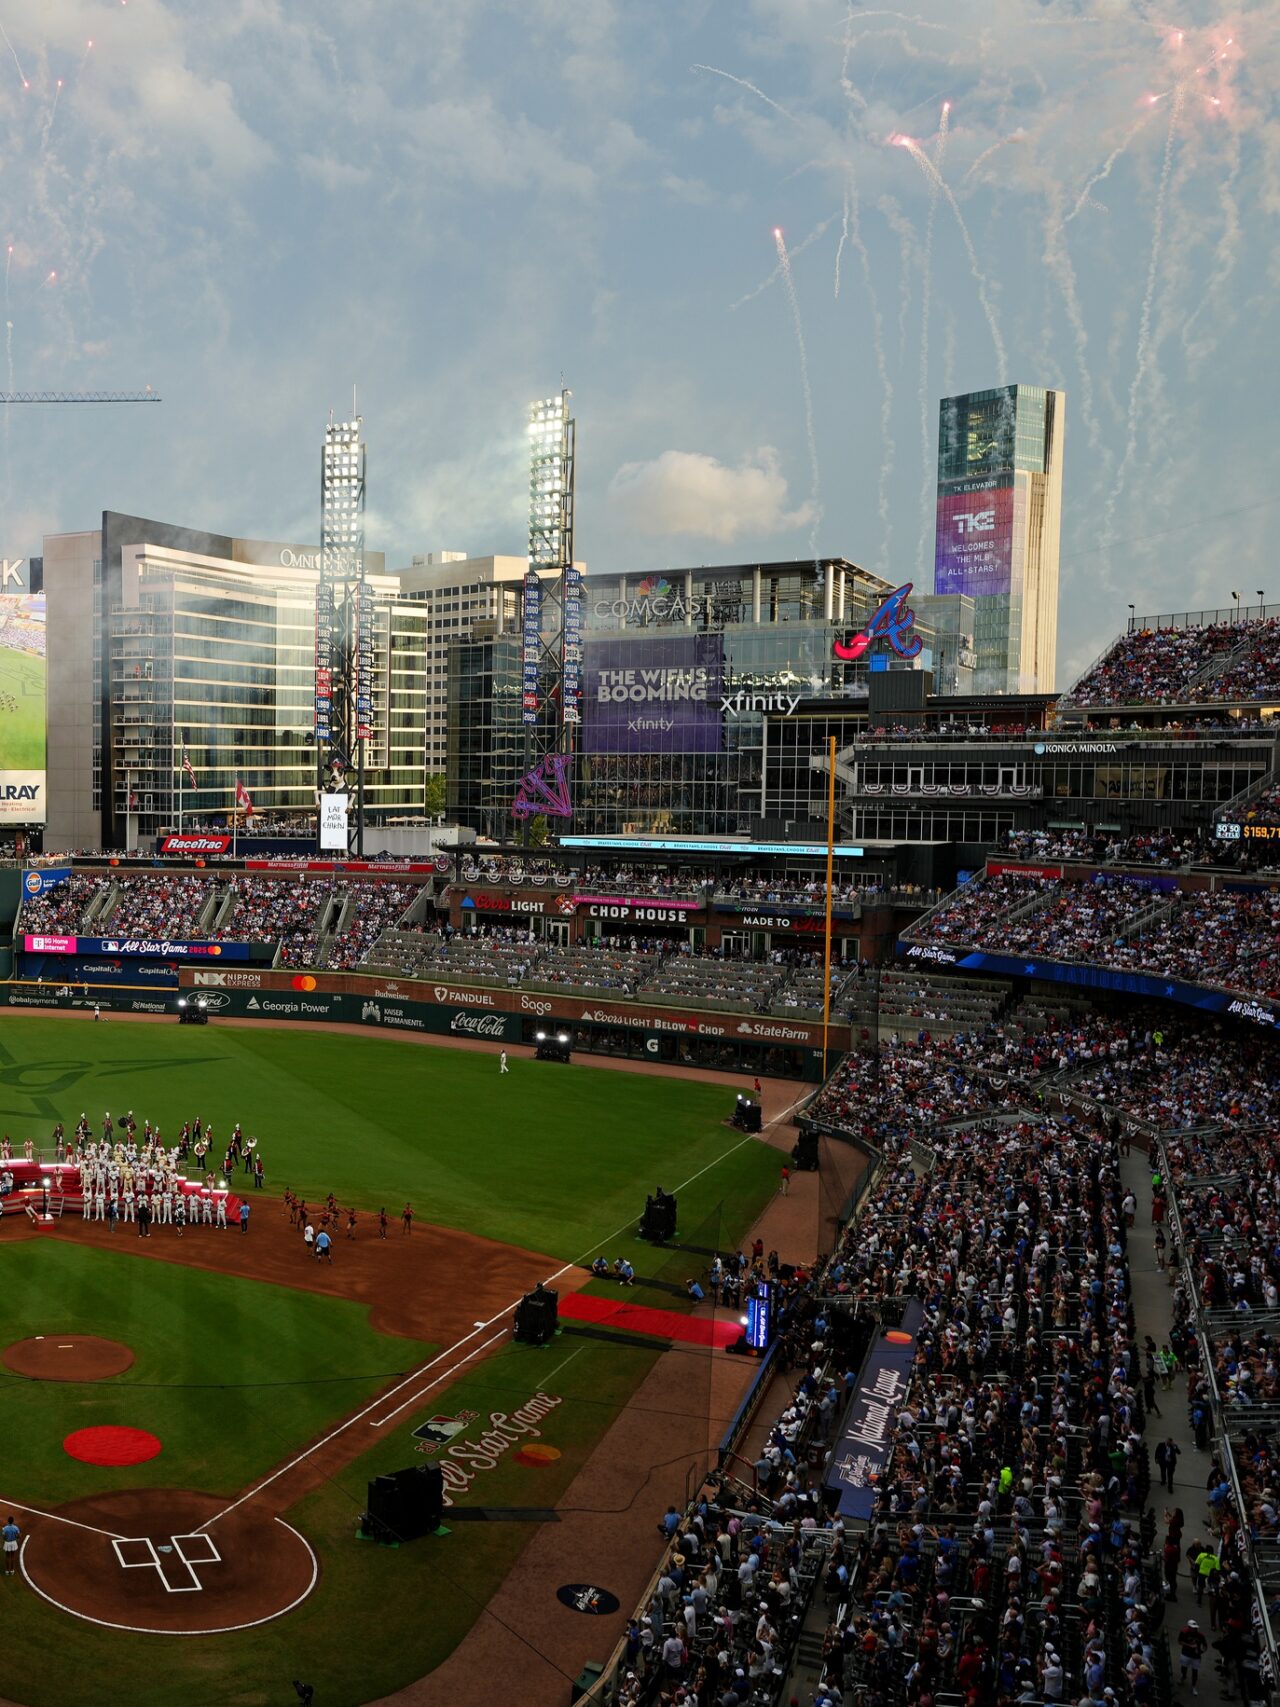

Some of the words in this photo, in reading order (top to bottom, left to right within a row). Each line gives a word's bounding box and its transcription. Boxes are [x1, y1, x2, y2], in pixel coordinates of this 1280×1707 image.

[964, 481, 997, 490] ELEVATOR
[953, 511, 995, 534] TKE
[952, 541, 994, 553] WELCOMES
[280, 548, 315, 569] OMNI
[956, 555, 971, 563] THE
[974, 554, 990, 562] MLB
[567, 572, 580, 580] 1997
[567, 587, 580, 596] 1999
[526, 606, 538, 614] 2000
[594, 594, 715, 619] COMCAST
[526, 621, 538, 629] 2002
[525, 636, 538, 645] 2004
[565, 680, 578, 688] 2020
[598, 670, 636, 686] THE
[598, 684, 707, 702] BOOMING
[525, 697, 536, 705] 2021
[565, 695, 577, 704] 2022
[720, 691, 801, 716] xfinity
[564, 711, 576, 719] 2024
[627, 717, 674, 731] xfinity
[1045, 744, 1078, 753] KONICA
[1079, 744, 1116, 753] MINOLTA
[168, 838, 223, 850] RaceTrac
[267, 862, 308, 870] MATTRESSFIRM
[367, 863, 411, 871] MATTRESSFIRM
[475, 895, 510, 910] Coors
[512, 901, 544, 912] LIGHT
[590, 905, 629, 918] CHOP
[636, 908, 687, 922] HOUSE
[743, 916, 773, 927] MADE
[776, 918, 791, 927] TO
[120, 941, 139, 952] All
[139, 941, 160, 953] Star
[162, 942, 188, 956] Game
[906, 946, 922, 956] All
[922, 947, 937, 958] Star
[227, 974, 261, 982] NIPPON
[375, 990, 410, 1000] Budweiser
[449, 992, 495, 1005] FANDUEL
[262, 1001, 298, 1013] Georgia
[300, 1003, 330, 1013] Power
[521, 996, 552, 1016] Sage
[1228, 1000, 1242, 1013] All
[1242, 1003, 1256, 1017] Star
[384, 1008, 403, 1017] KAISER
[384, 1016, 424, 1027] PERMANENTE
[593, 1011, 622, 1023] Coors
[624, 1017, 651, 1027] LIGHT
[654, 1019, 687, 1032] BELOW
[698, 1024, 725, 1036] CHOP
[646, 1039, 659, 1052] G
[861, 1368, 907, 1405] League
[490, 1392, 562, 1437] Game
[846, 1399, 890, 1452] National
[448, 1431, 519, 1470] Star
